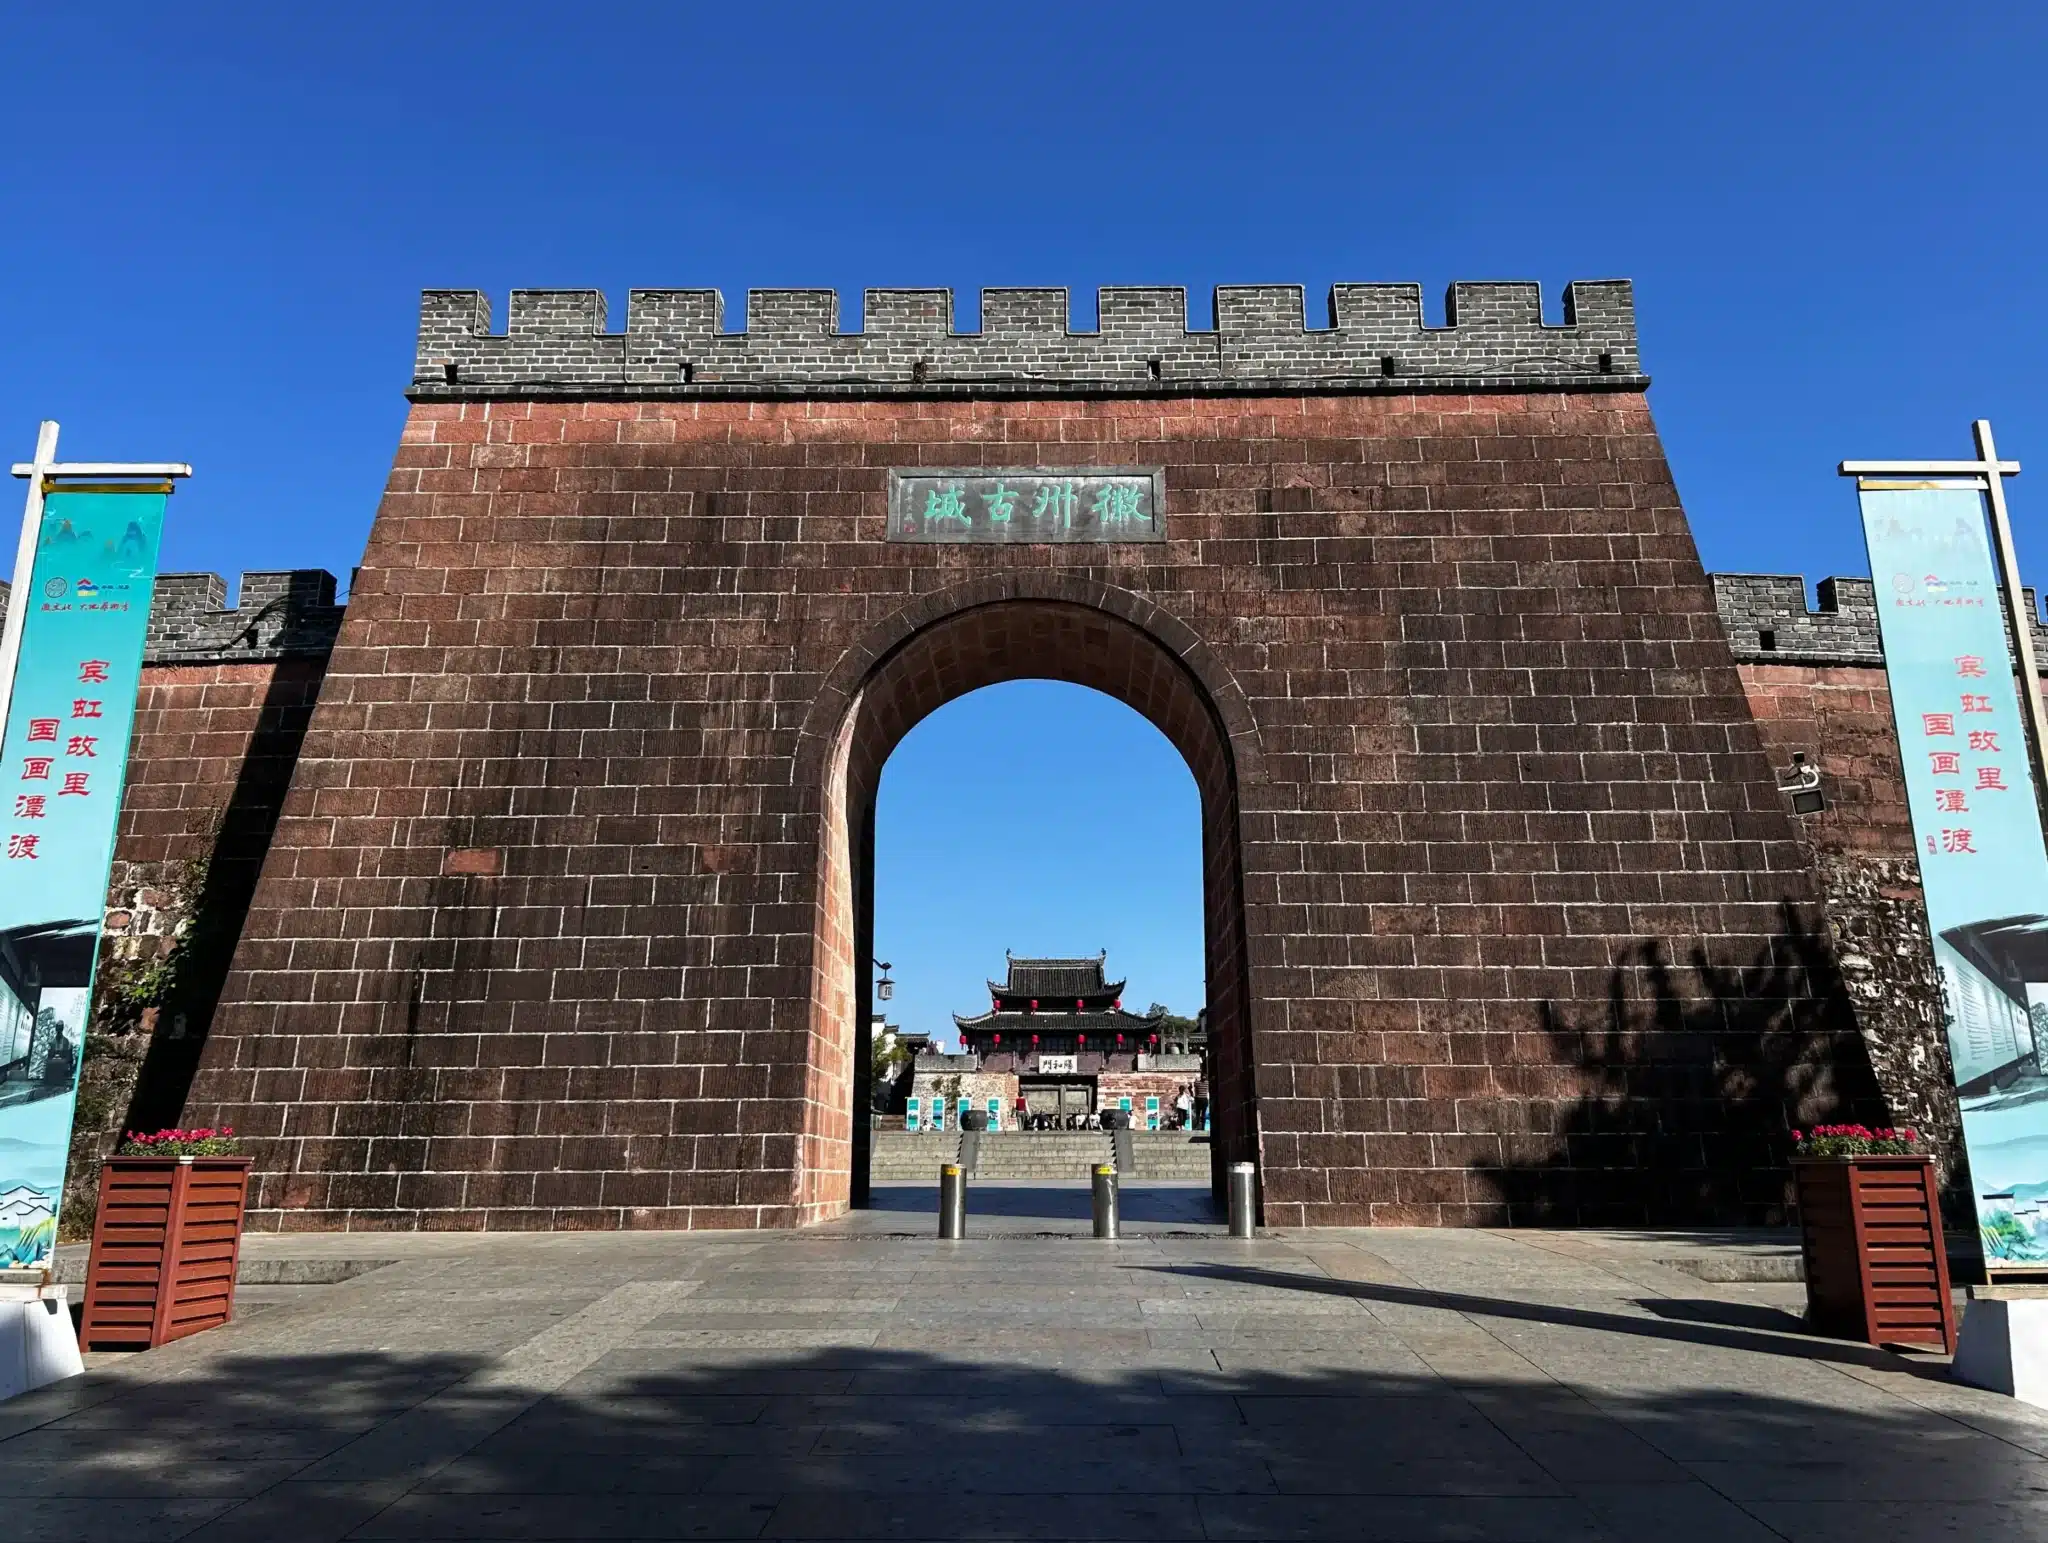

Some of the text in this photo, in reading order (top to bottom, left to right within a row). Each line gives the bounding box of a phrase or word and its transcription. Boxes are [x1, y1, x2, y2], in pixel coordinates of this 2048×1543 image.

[7, 718, 61, 860] 国画潭渡
[57, 660, 110, 797] 宾虹故里
[1922, 713, 1977, 854] 国画潭渡
[1954, 655, 2007, 791] 宾虹故里
